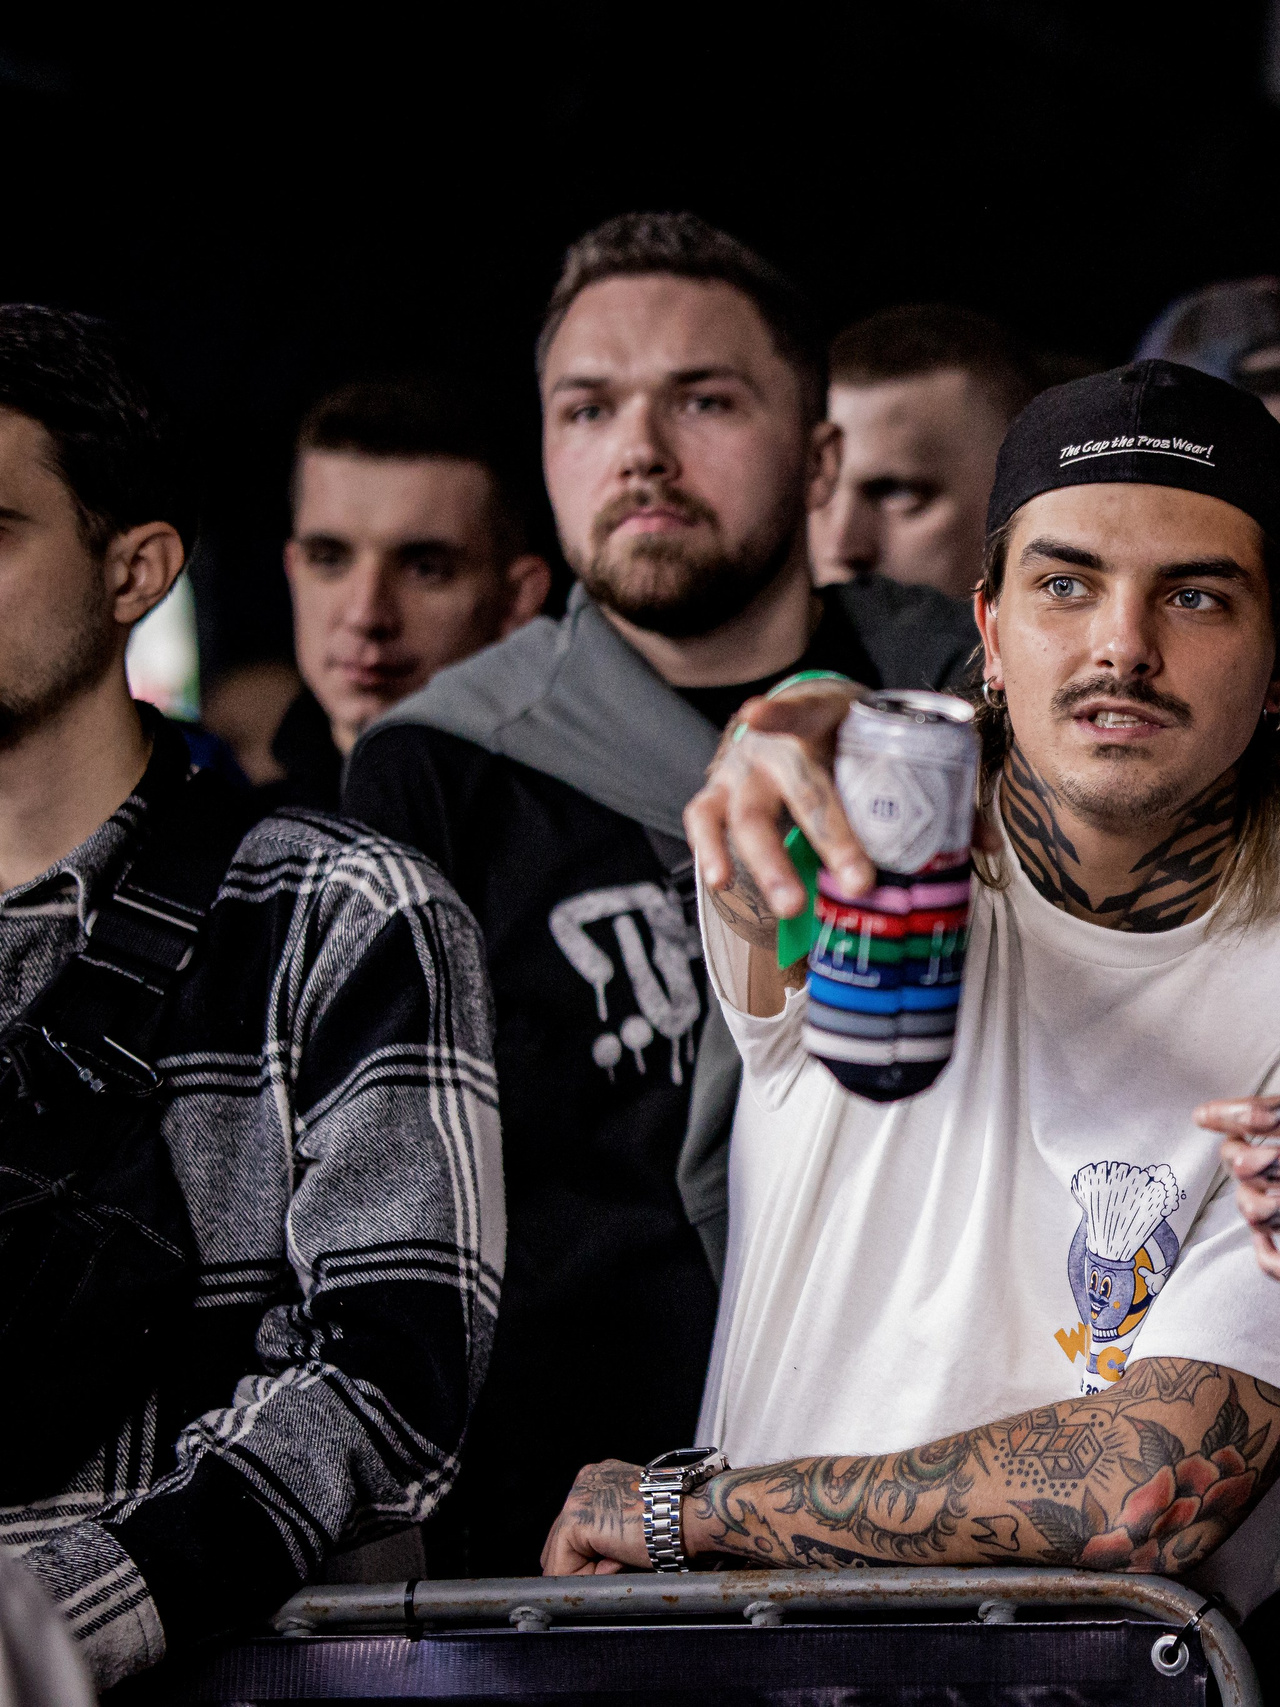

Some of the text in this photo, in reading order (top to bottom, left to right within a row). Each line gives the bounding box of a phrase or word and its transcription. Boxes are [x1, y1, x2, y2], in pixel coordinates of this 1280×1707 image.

[1059, 445, 1081, 459] The
[1082, 440, 1110, 453] Cap
[1111, 435, 1135, 449] the
[1172, 437, 1214, 459] Wear!
